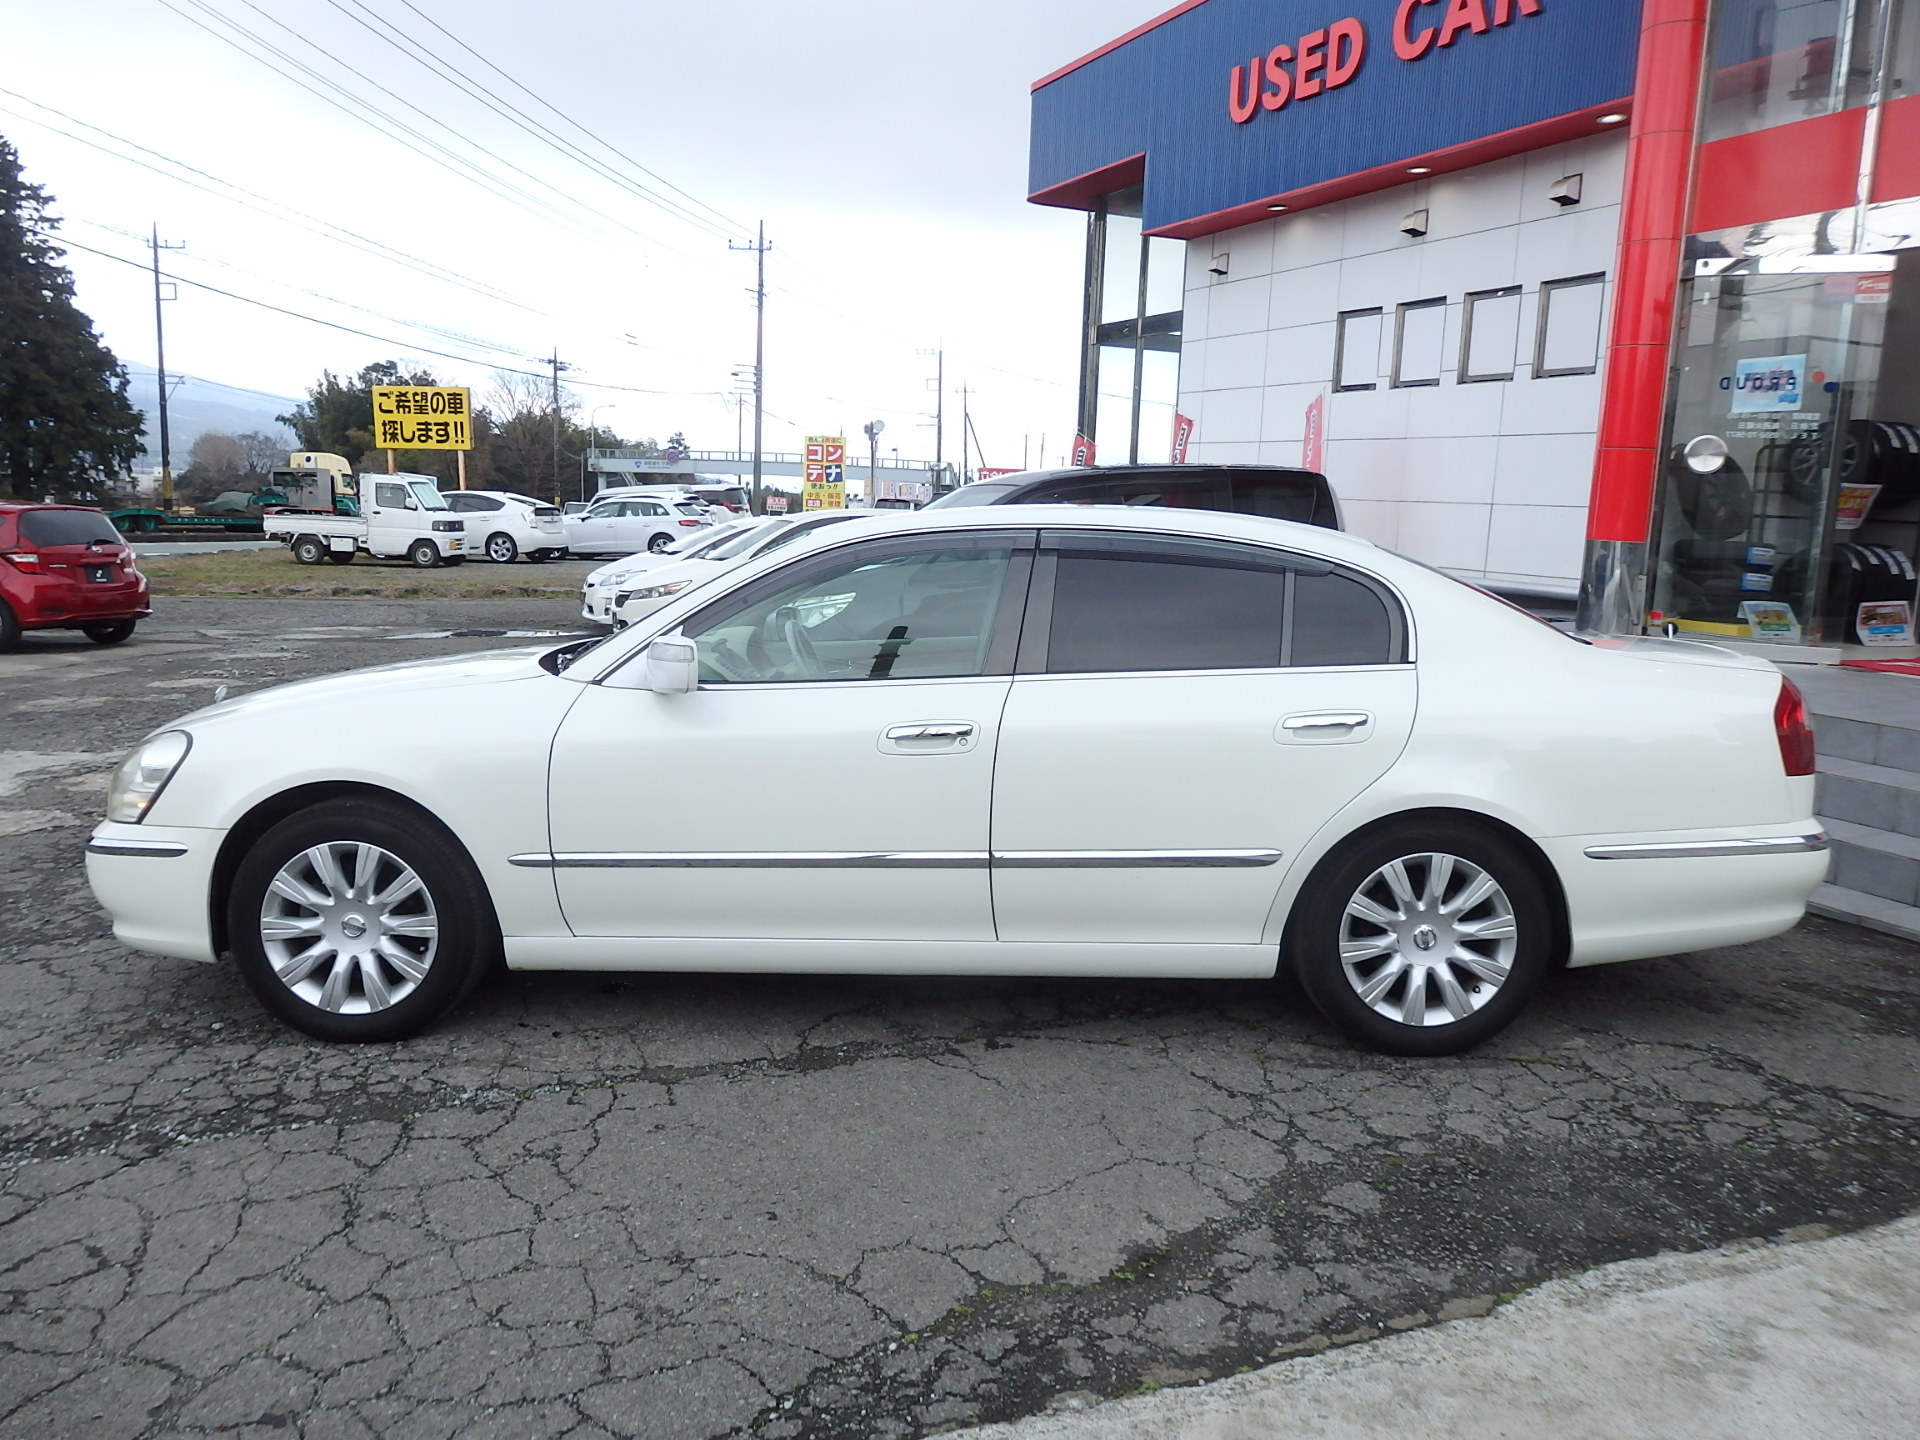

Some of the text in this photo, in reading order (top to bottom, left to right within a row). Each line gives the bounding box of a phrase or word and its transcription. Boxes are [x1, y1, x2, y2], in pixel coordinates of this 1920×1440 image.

[1228, 17, 1366, 124] USED
[378, 391, 465, 415] ご希望の車
